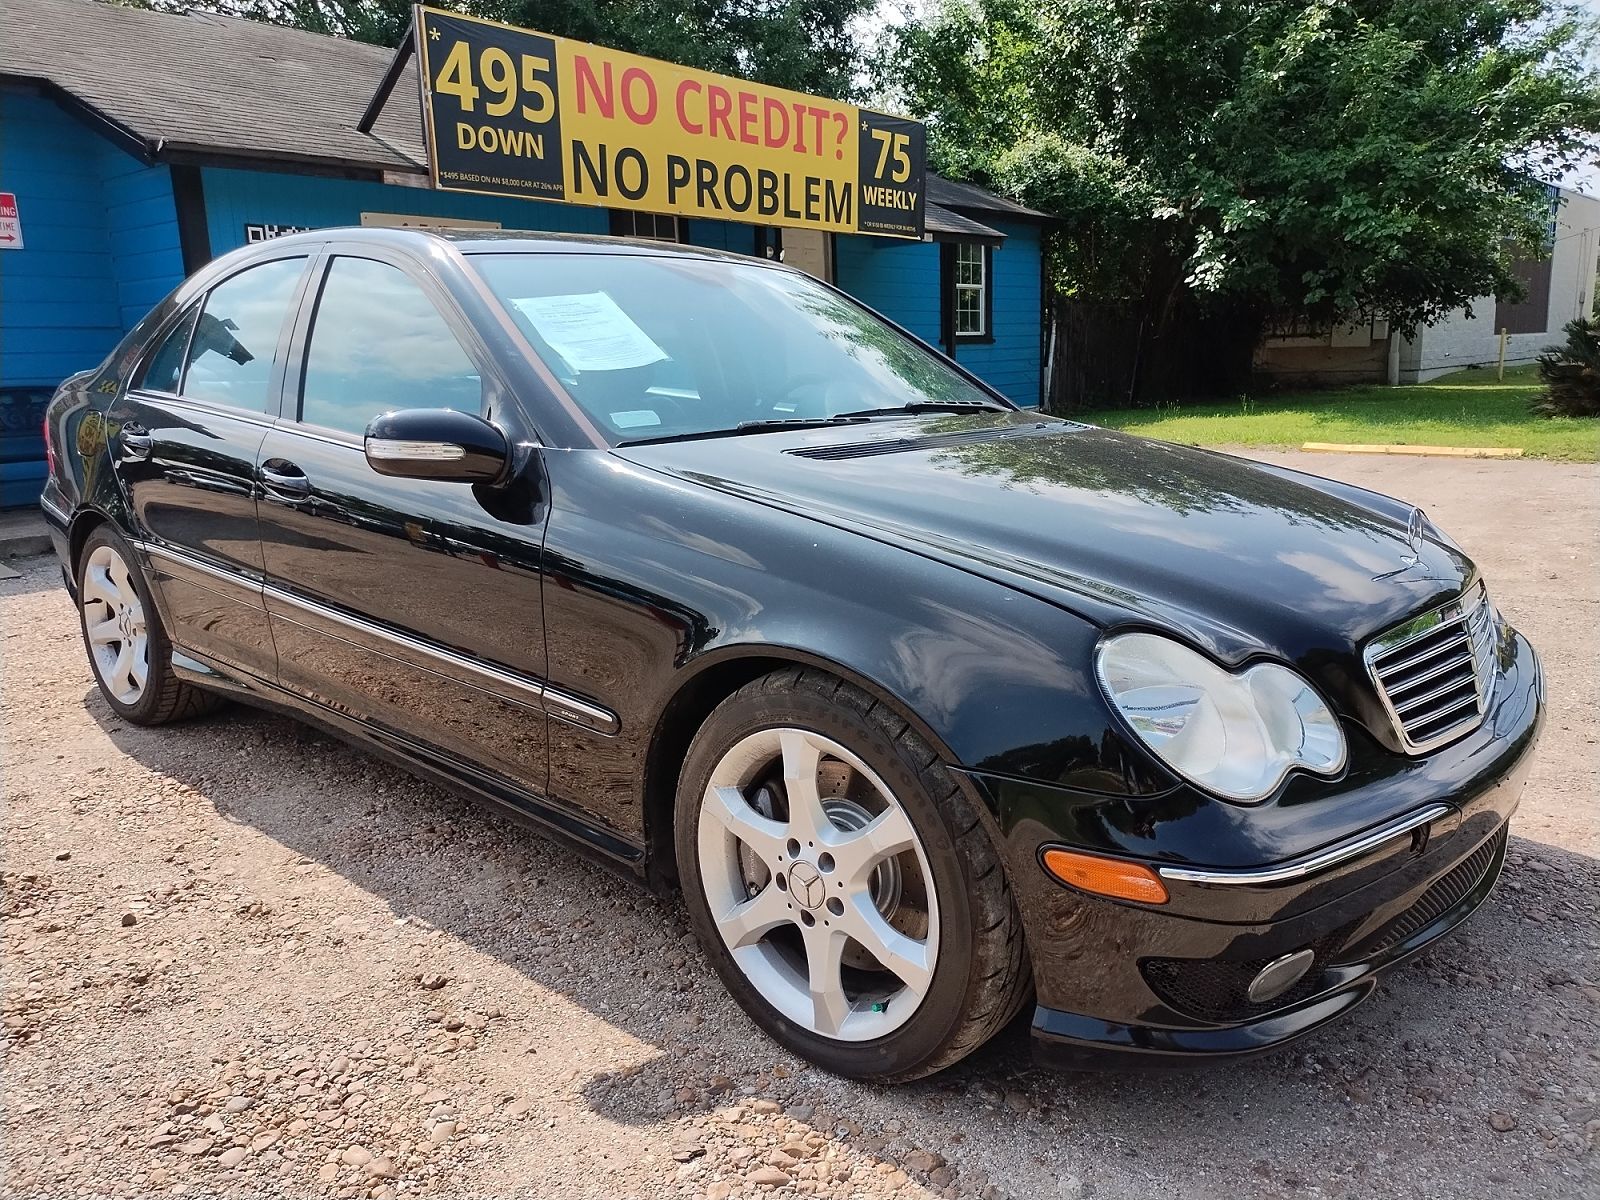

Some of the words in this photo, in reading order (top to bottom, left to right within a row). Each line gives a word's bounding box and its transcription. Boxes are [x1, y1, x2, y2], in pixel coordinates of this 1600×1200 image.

[574, 55, 658, 126] NO
[675, 79, 849, 160] CREDIT?
[457, 122, 544, 160] DOWN
[460, 173, 480, 182] BASED
[481, 175, 491, 183] ON
[492, 177, 501, 185] AN
[521, 180, 532, 188] CAR
[571, 139, 649, 201] NO
[666, 154, 853, 225] PROBLEM
[863, 184, 917, 211] WEEKLY
